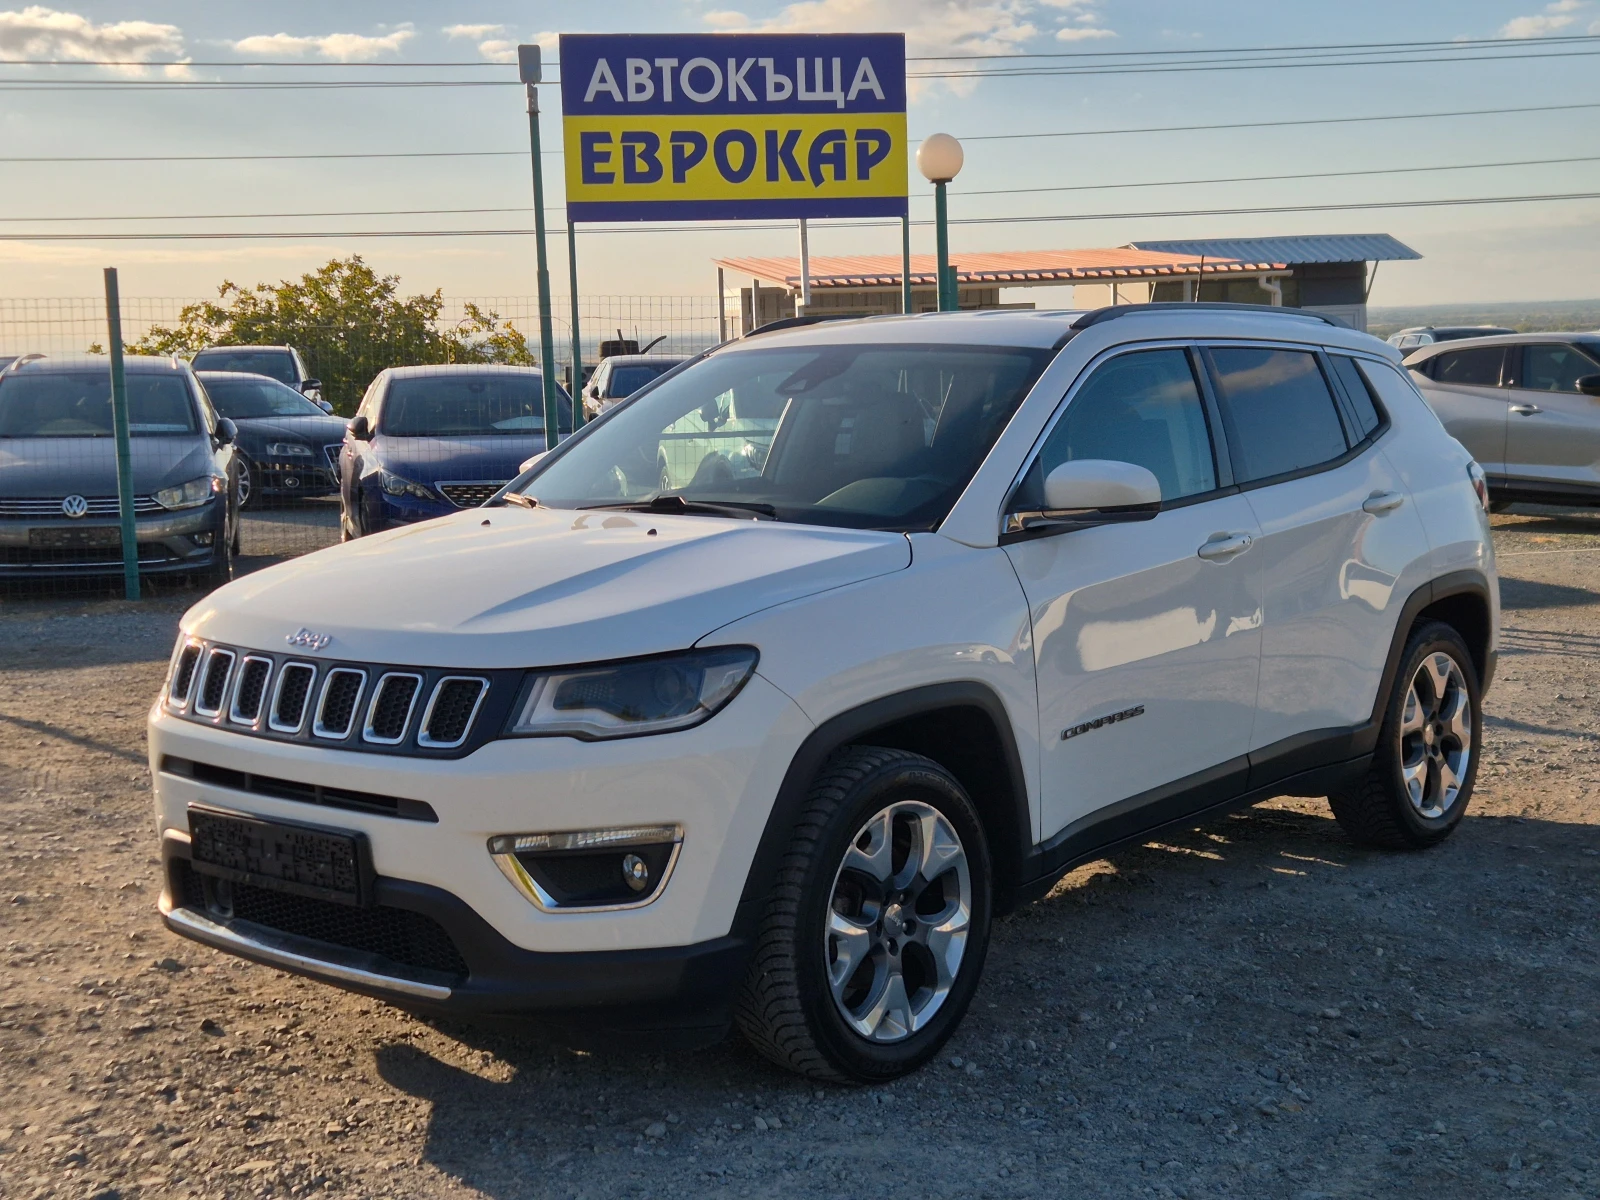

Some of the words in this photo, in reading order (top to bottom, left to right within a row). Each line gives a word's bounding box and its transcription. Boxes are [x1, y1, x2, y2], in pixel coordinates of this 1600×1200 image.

[583, 57, 886, 109] АВТОКЪЩА
[580, 128, 892, 188] ЕВРОКАР
[285, 626, 332, 652] Jeep
[1060, 704, 1145, 741] COMPASS
